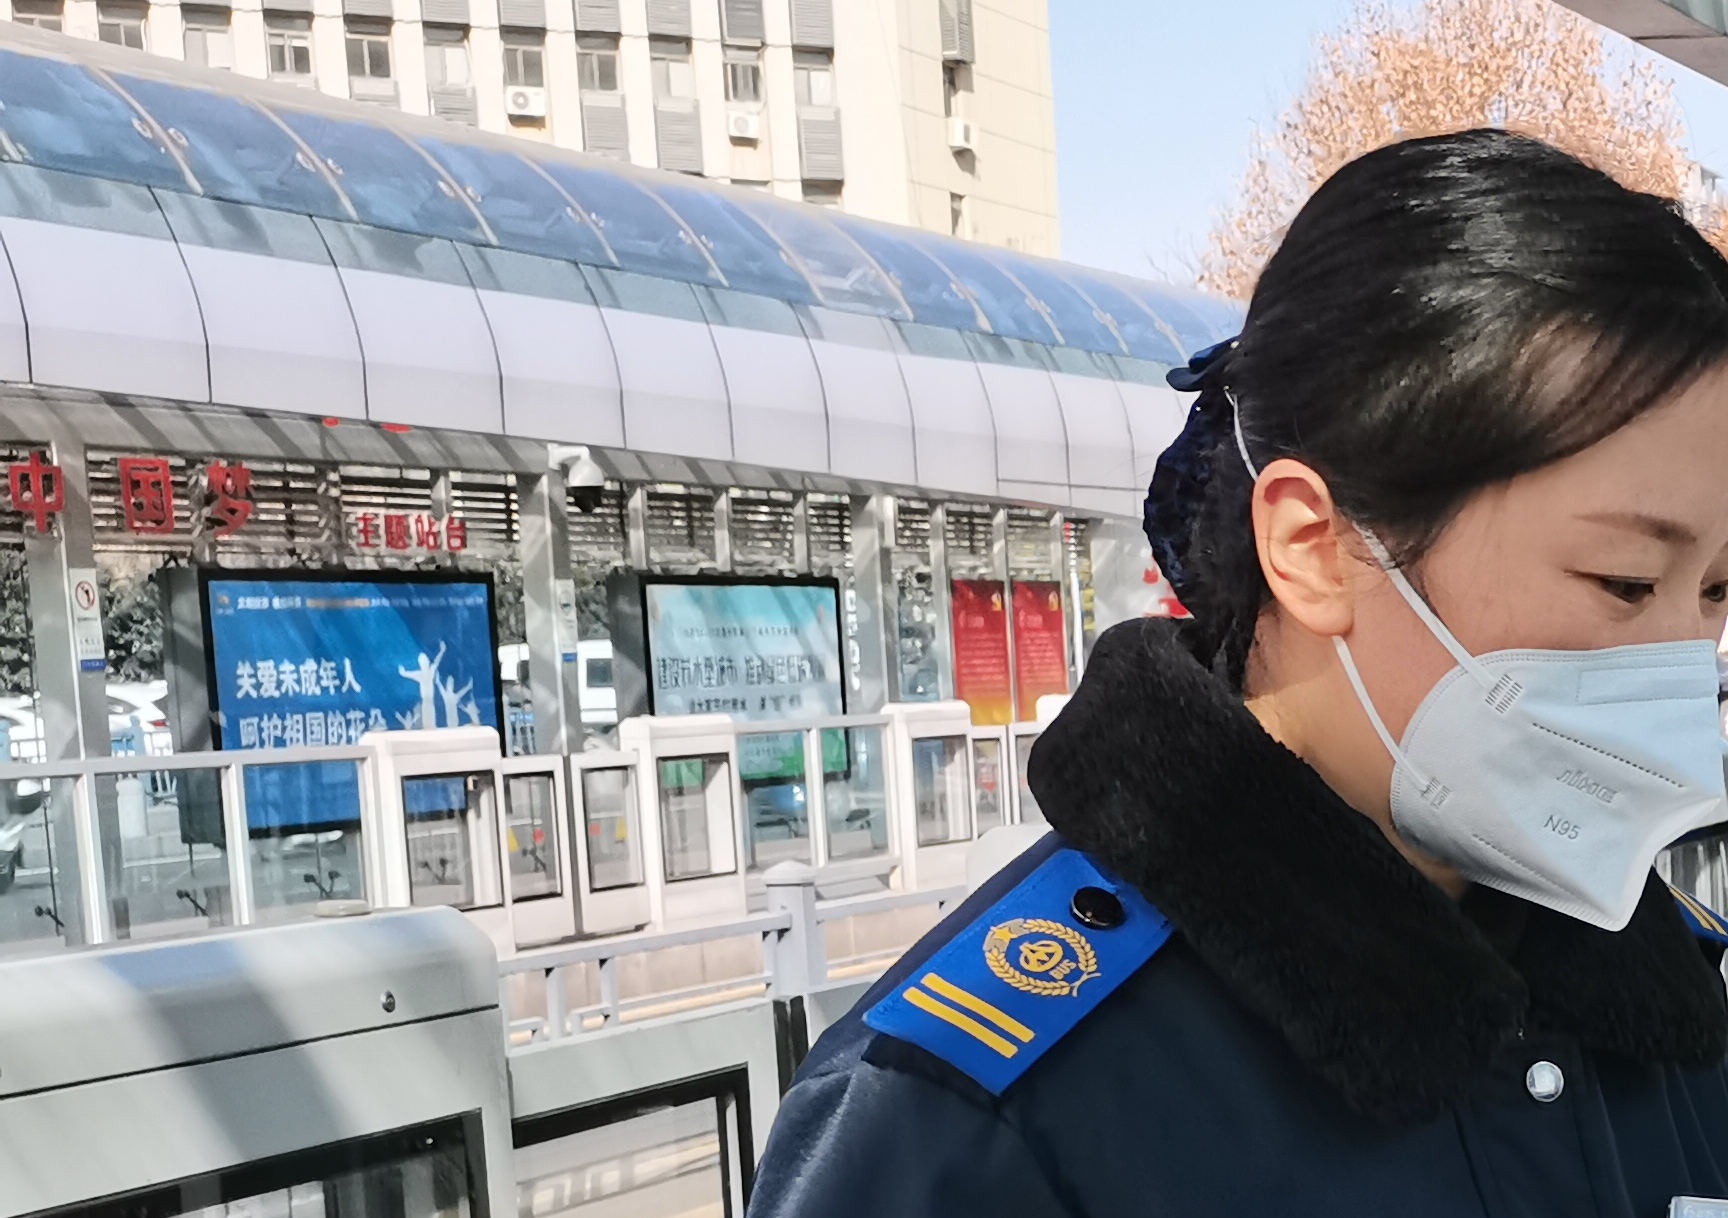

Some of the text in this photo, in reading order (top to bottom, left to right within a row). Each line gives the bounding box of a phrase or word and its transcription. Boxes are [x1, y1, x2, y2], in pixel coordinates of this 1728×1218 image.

[9, 452, 253, 538] 中国梦
[356, 512, 467, 551] 主题站台
[236, 656, 362, 699] 关爱未成年人
[1543, 814, 1581, 840] N95
[1049, 959, 1077, 980] BUS
